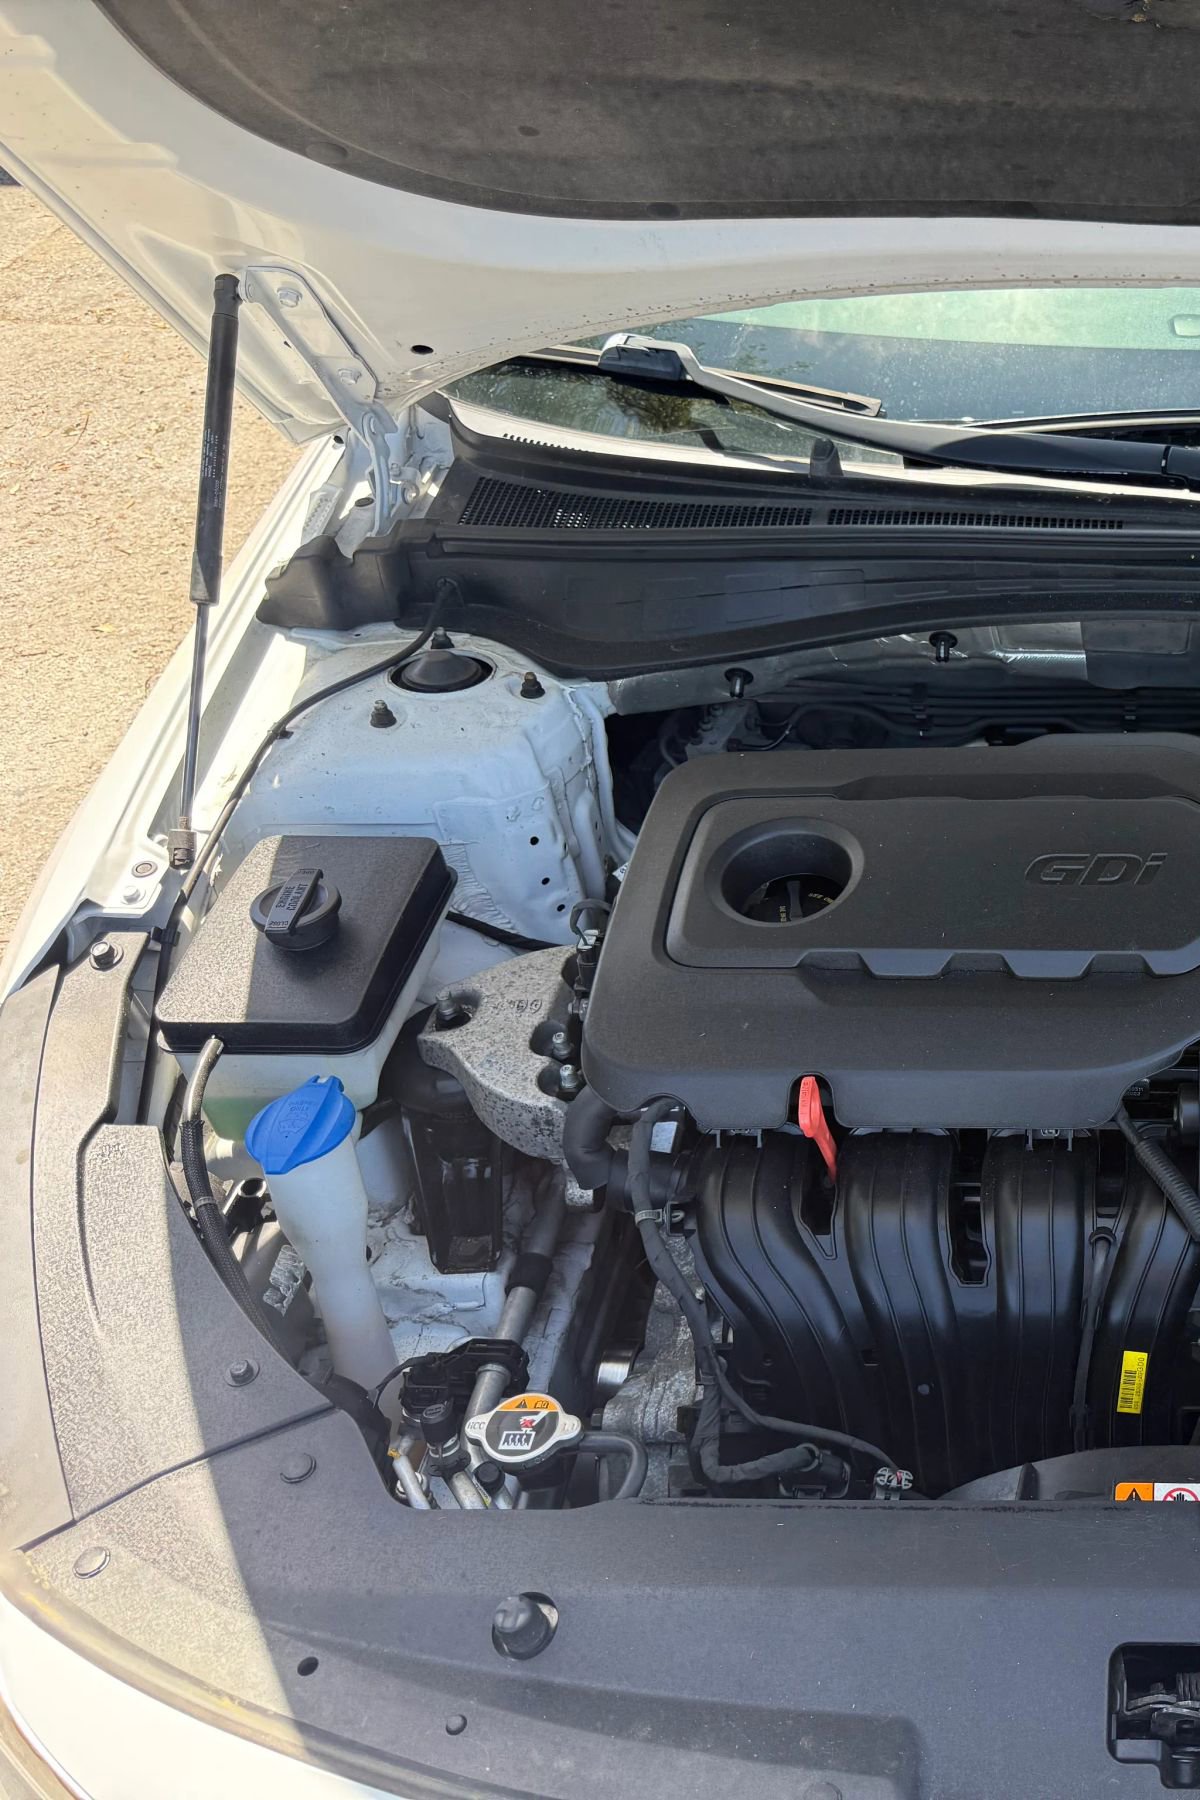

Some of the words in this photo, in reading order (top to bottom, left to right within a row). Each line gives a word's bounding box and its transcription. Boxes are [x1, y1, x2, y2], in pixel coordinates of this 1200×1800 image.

[1024, 853, 1168, 886] GDi
[275, 886, 297, 908] ENGINE
[286, 883, 309, 911] COOLANT
